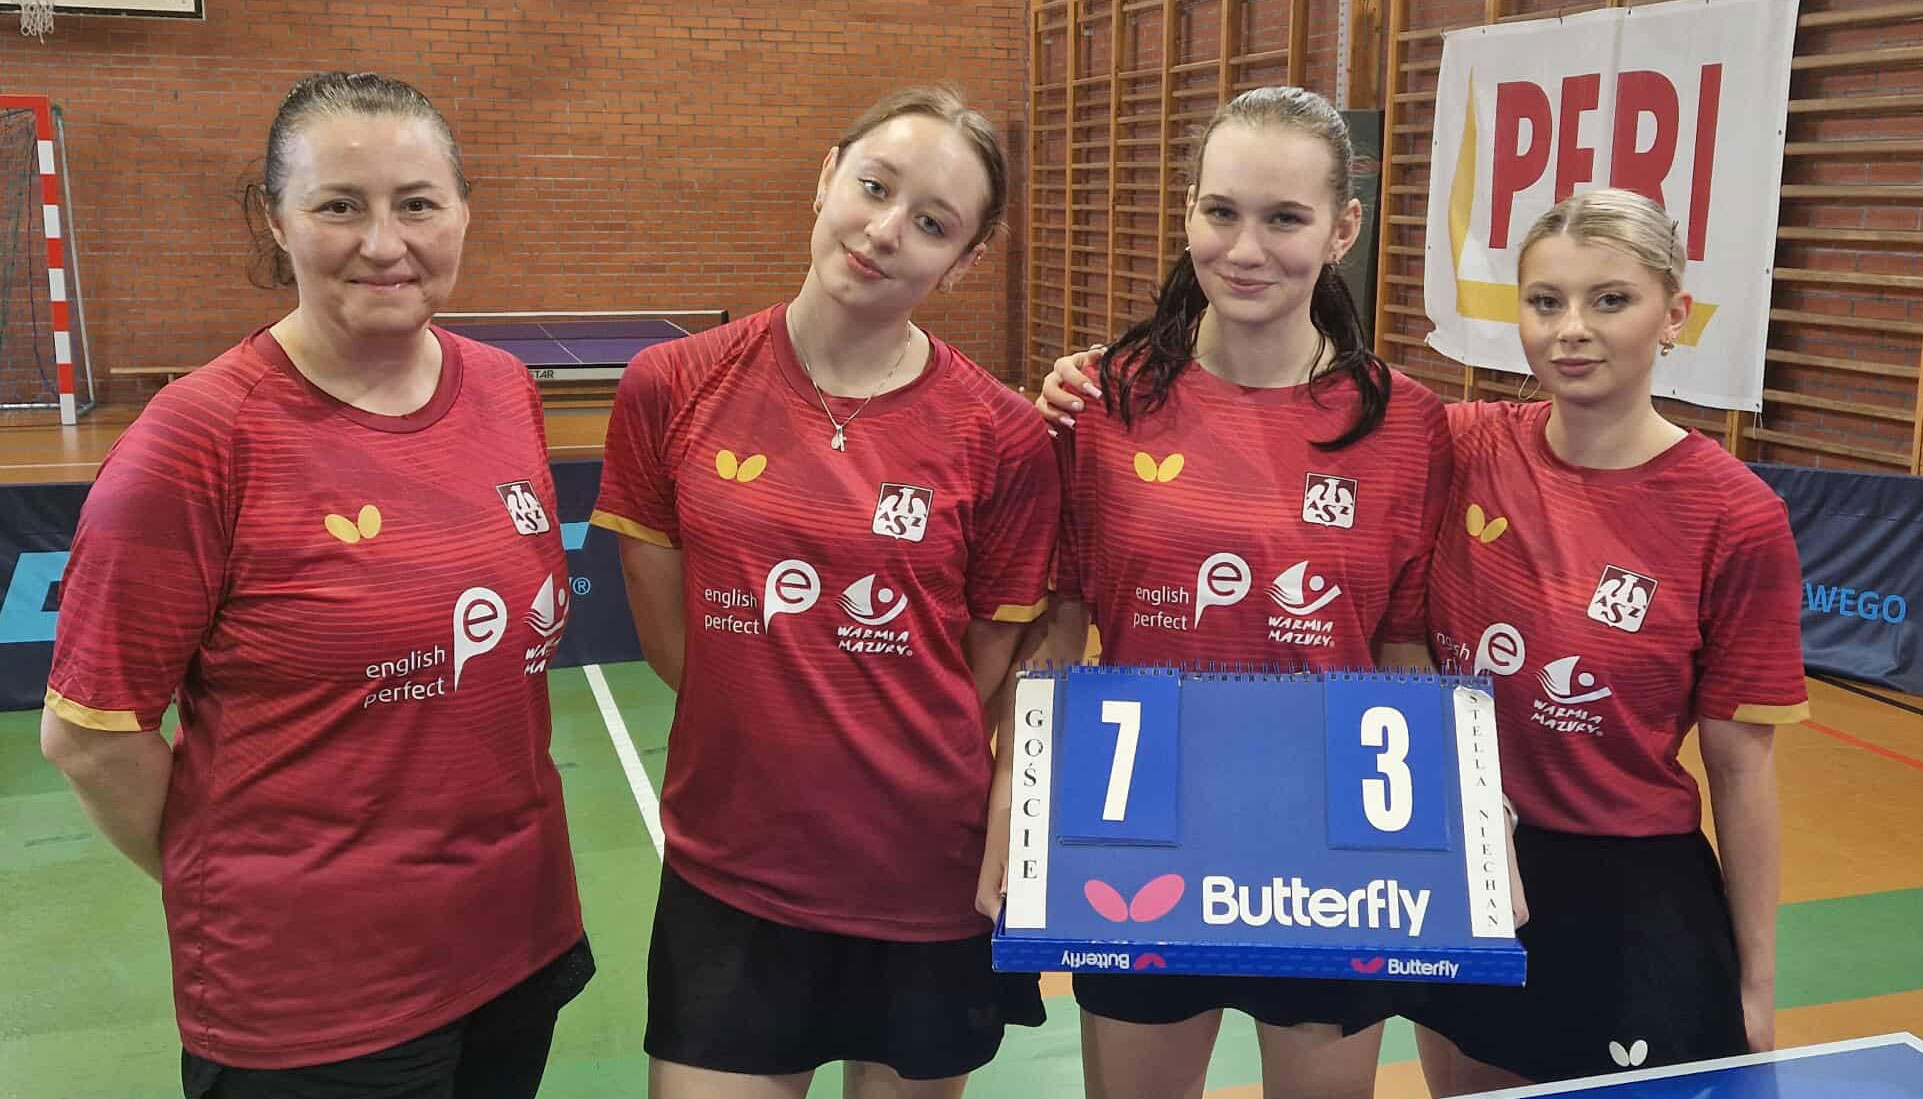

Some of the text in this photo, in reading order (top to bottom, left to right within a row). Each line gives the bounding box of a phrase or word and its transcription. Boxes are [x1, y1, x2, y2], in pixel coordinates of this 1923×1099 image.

[1489, 63, 1722, 261] PERI
[704, 587, 758, 608] english
[1135, 586, 1190, 607] english
[704, 614, 760, 635] perfect
[1133, 611, 1188, 631] perfect
[1268, 615, 1334, 633] WARMIA
[837, 625, 910, 643] WARMIA
[366, 645, 446, 678] english
[364, 677, 445, 708] perfect
[1101, 700, 1142, 821] 7
[1360, 706, 1413, 832] 3
[1022, 709, 1045, 879] GOŚCIE
[1202, 876, 1431, 937] Butterfly
[1061, 950, 1130, 969] Butterfly
[1387, 958, 1459, 979] Butterfly
